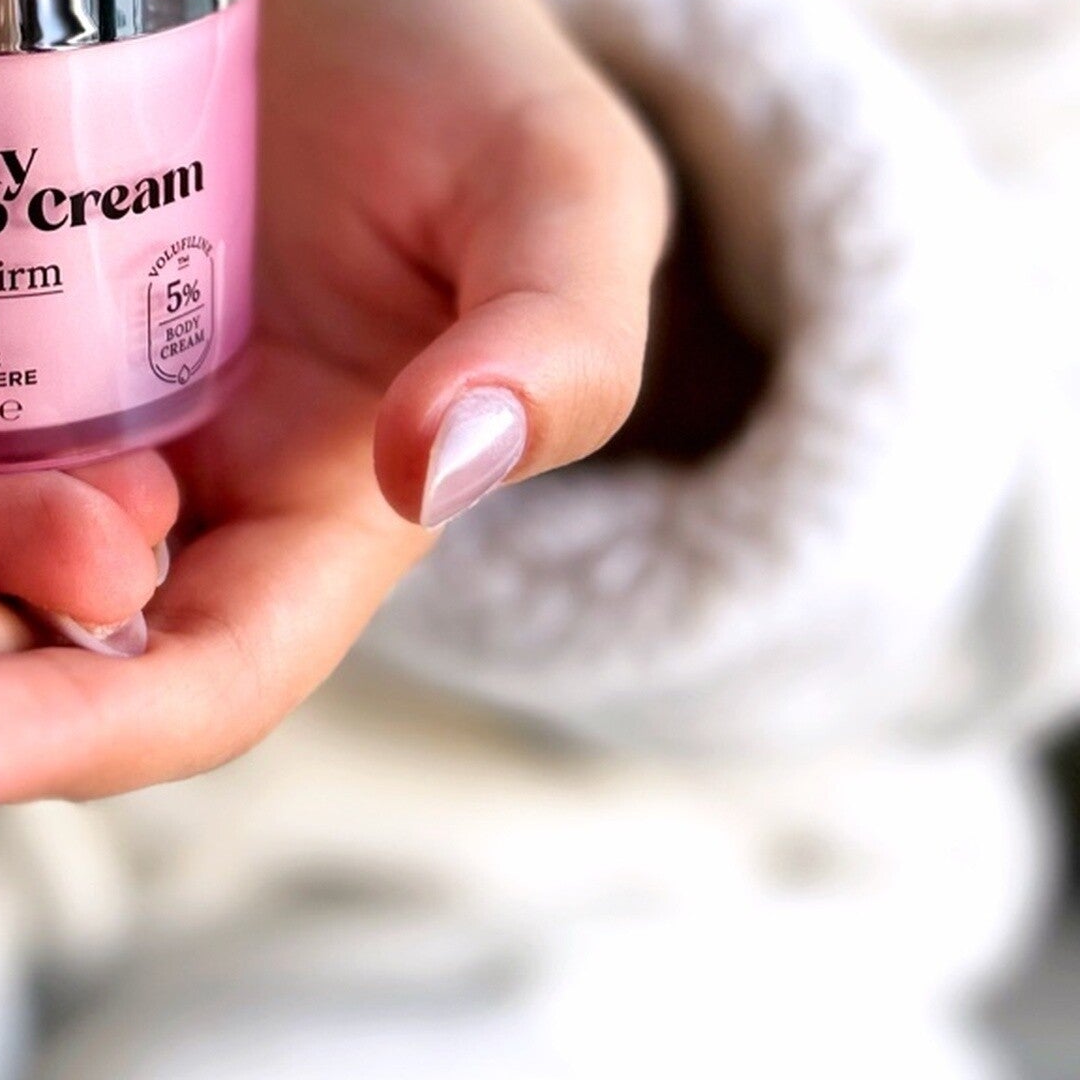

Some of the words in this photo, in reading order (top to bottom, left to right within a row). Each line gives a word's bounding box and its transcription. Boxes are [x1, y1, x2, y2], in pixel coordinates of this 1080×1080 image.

[27, 160, 205, 233] Cream
[166, 278, 201, 314] 5%
[160, 329, 206, 360] CREAM
[165, 315, 200, 342] BODY
